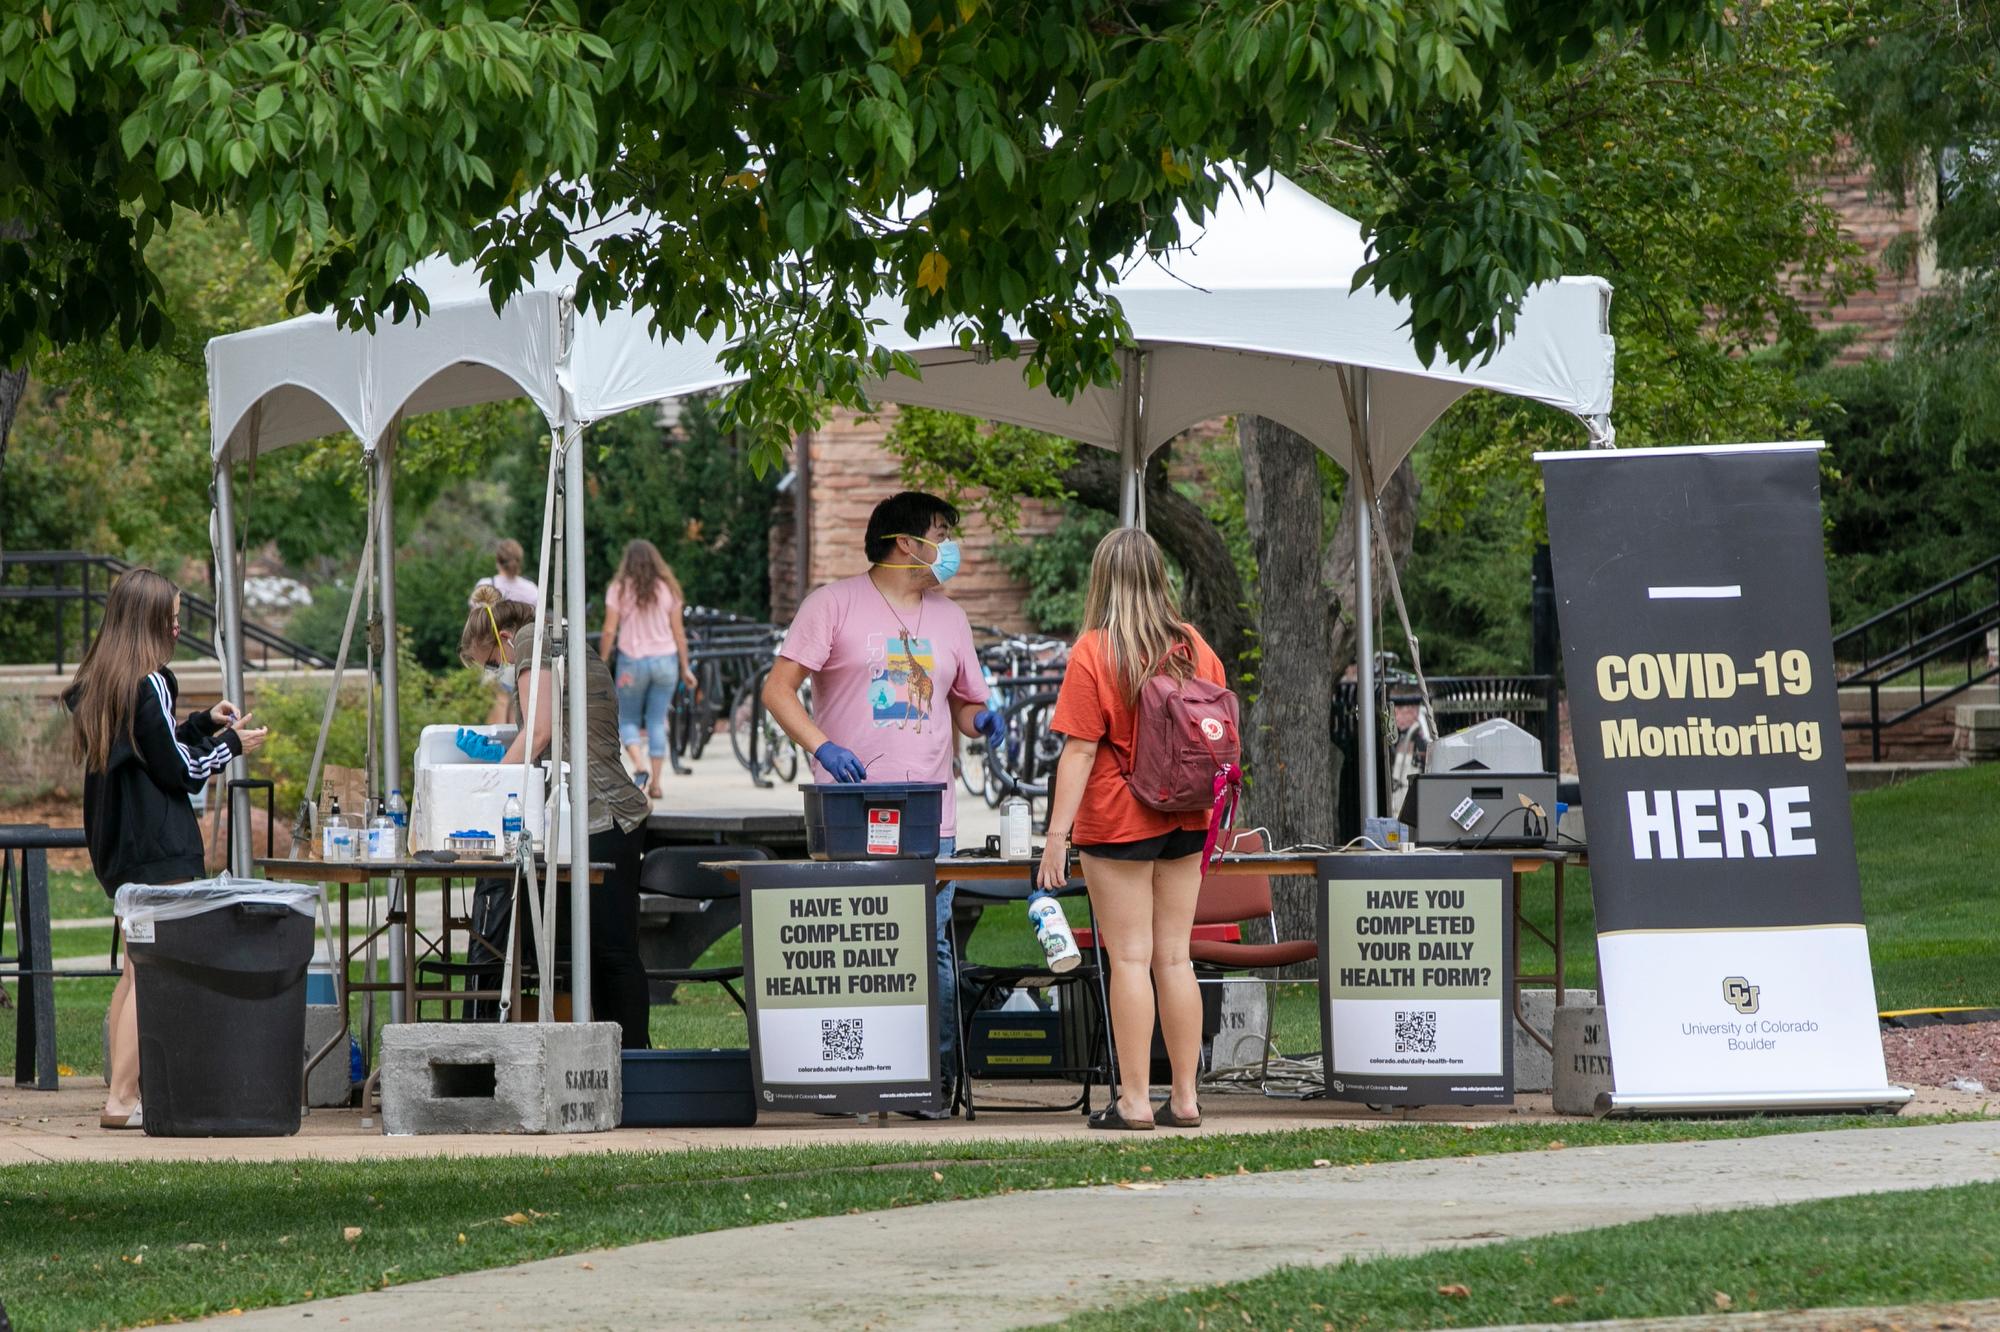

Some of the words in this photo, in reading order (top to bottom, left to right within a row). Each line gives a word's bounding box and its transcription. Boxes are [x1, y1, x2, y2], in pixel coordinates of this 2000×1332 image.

[1596, 649, 1812, 701] COVID-19
[1600, 715, 1822, 761] Monitoring
[1627, 785, 1817, 859] HERE
[790, 898, 842, 918] HAVE
[848, 896, 888, 916] YOU
[1366, 890, 1419, 909] HAVE
[1425, 890, 1465, 909] YOU
[780, 922, 900, 944] COMPLETED
[1356, 916, 1475, 935] COMPLETED
[782, 950, 836, 970] YOUR
[843, 948, 899, 968] DAILY
[1357, 942, 1411, 961] YOUR
[1418, 942, 1474, 961] DAILY
[766, 976, 841, 996] HEALTH
[848, 973, 917, 994] FORM?
[1340, 968, 1415, 987] HEALTH
[1422, 967, 1491, 987] FORM?
[1681, 1022, 1742, 1036] University
[1745, 1020, 1758, 1033] of
[1761, 1019, 1819, 1033] Colorado
[1727, 1038, 1776, 1051] Boulder
[797, 1064, 891, 1073] colorado.edu/daily-health-form
[1369, 1057, 1463, 1065] colorado.edu/daily-health-form
[1574, 1054, 1612, 1075] EVENT
